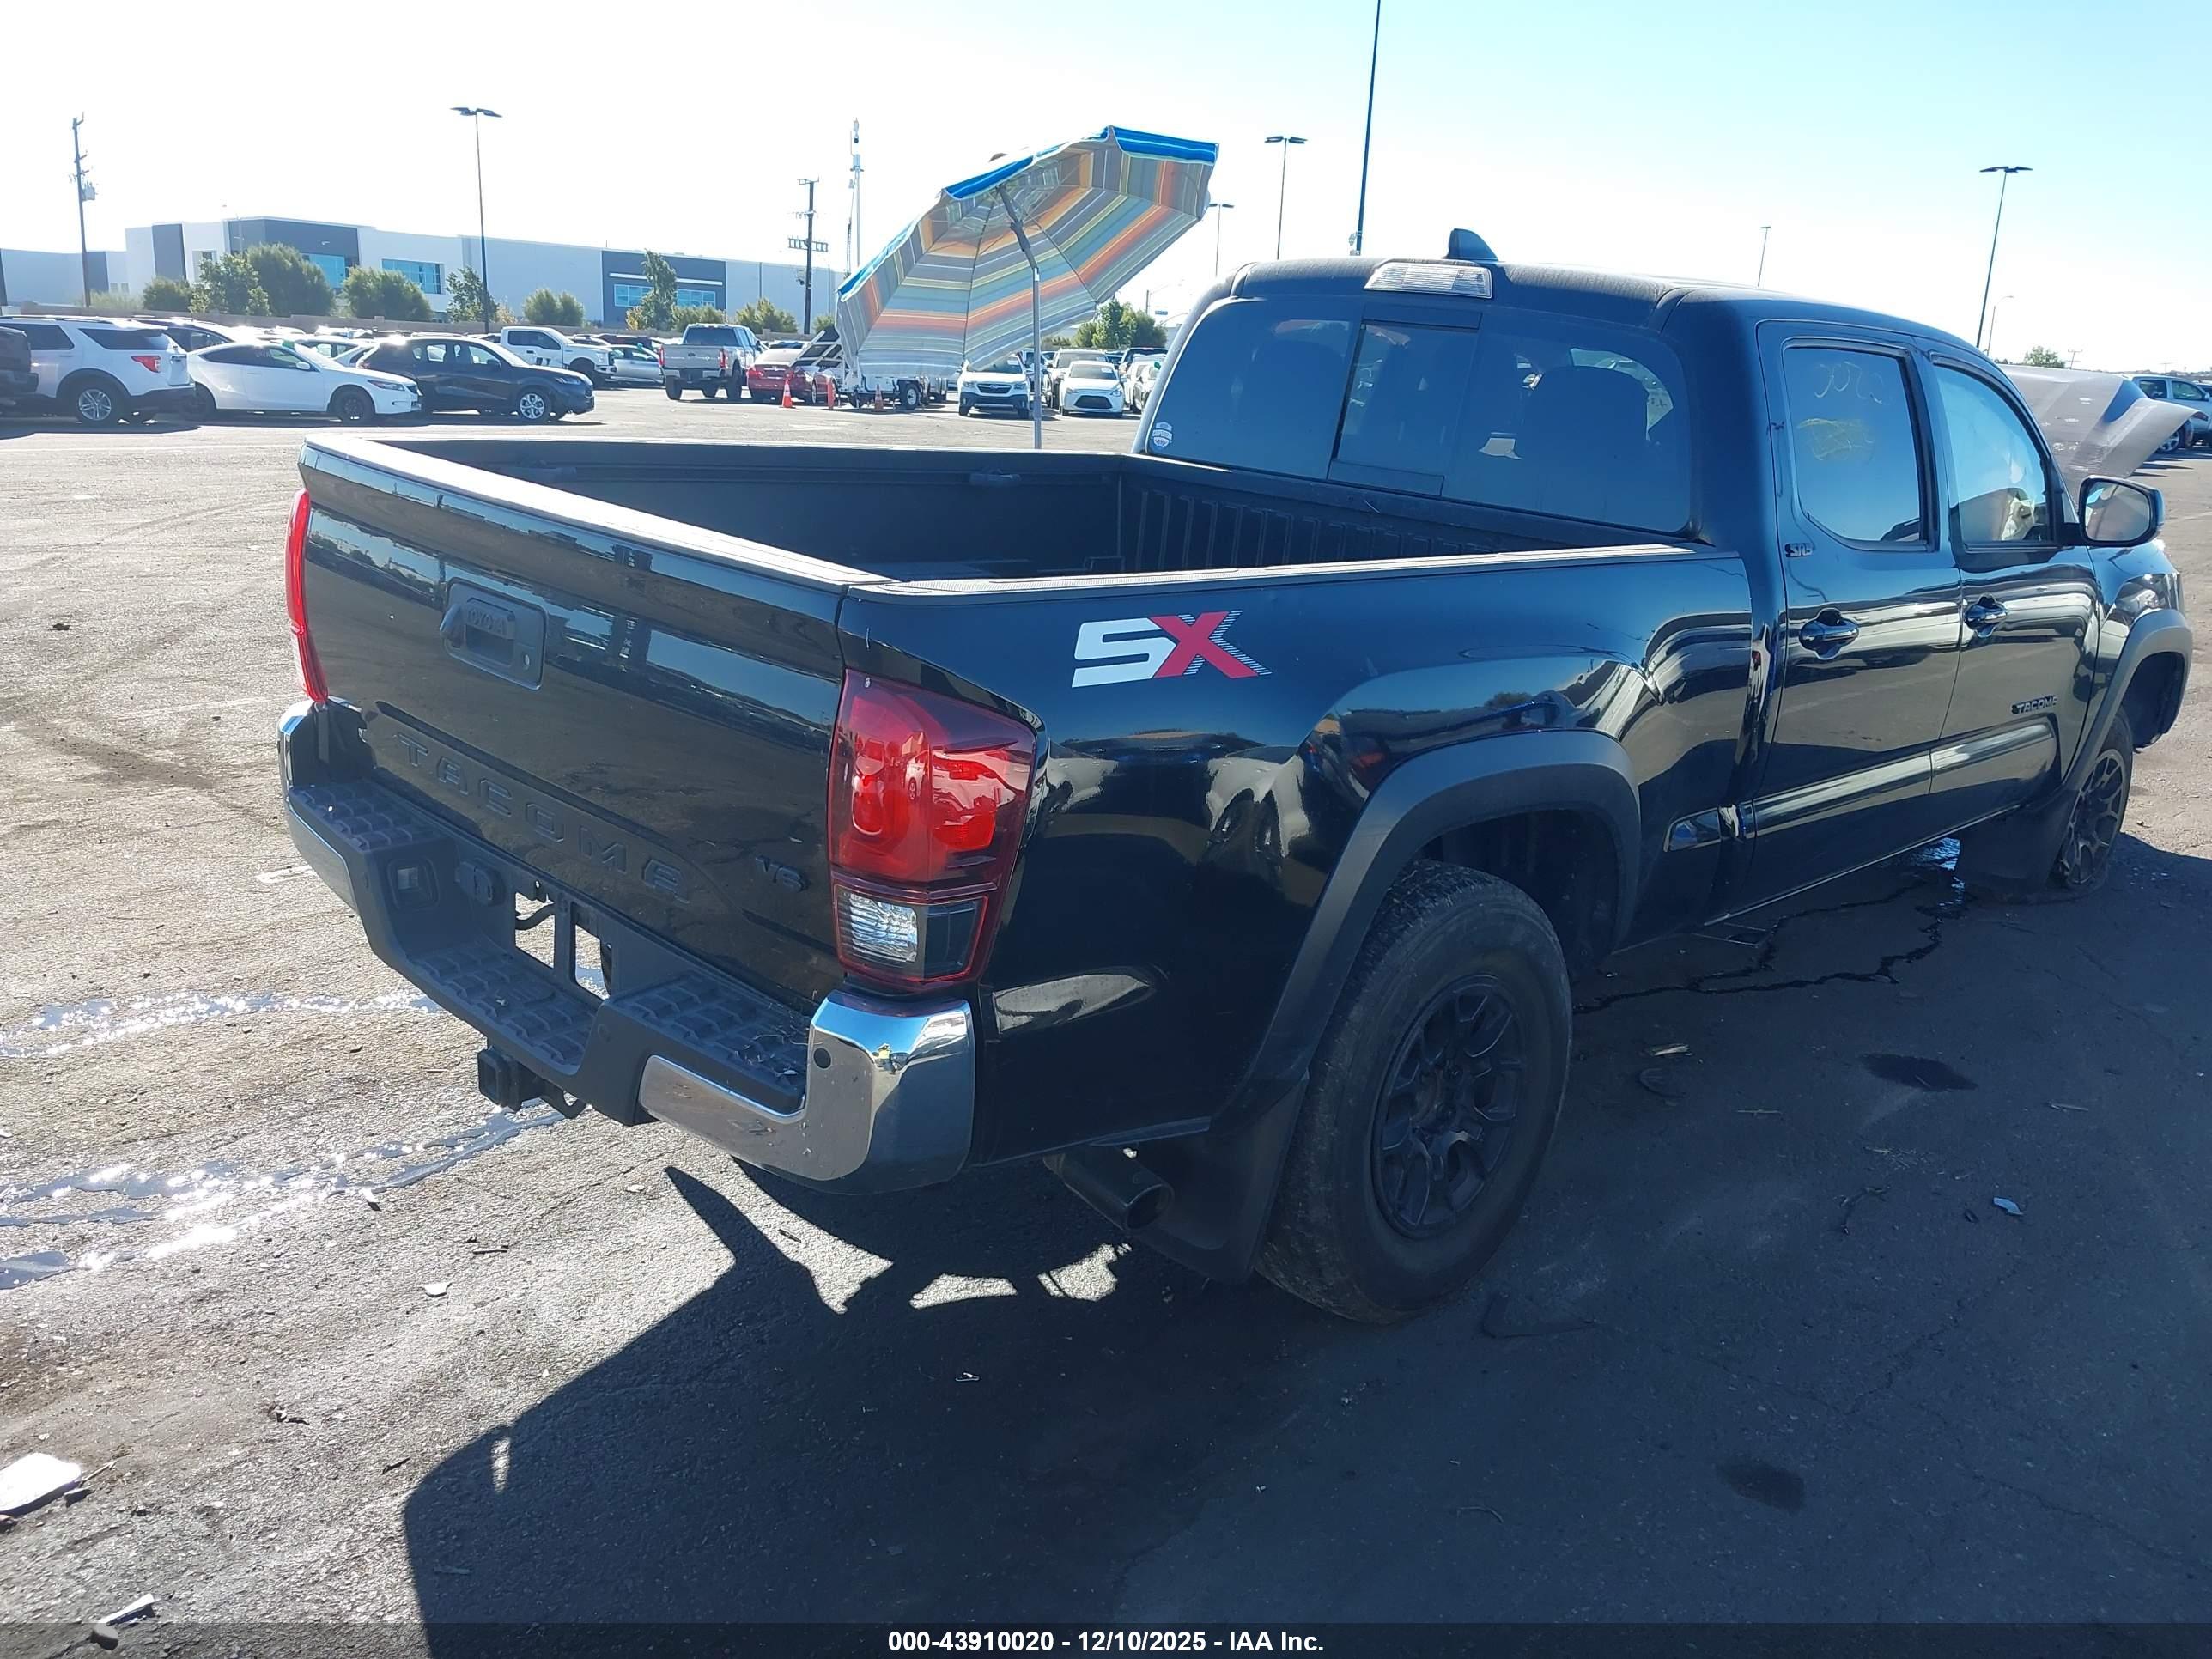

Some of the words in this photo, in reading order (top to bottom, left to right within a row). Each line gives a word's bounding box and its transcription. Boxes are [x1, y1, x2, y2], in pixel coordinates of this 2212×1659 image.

[1072, 611, 1272, 688] SX
[2012, 695, 2058, 714] TACOMA
[398, 732, 690, 903] TACOMA
[756, 856, 811, 892] V6
